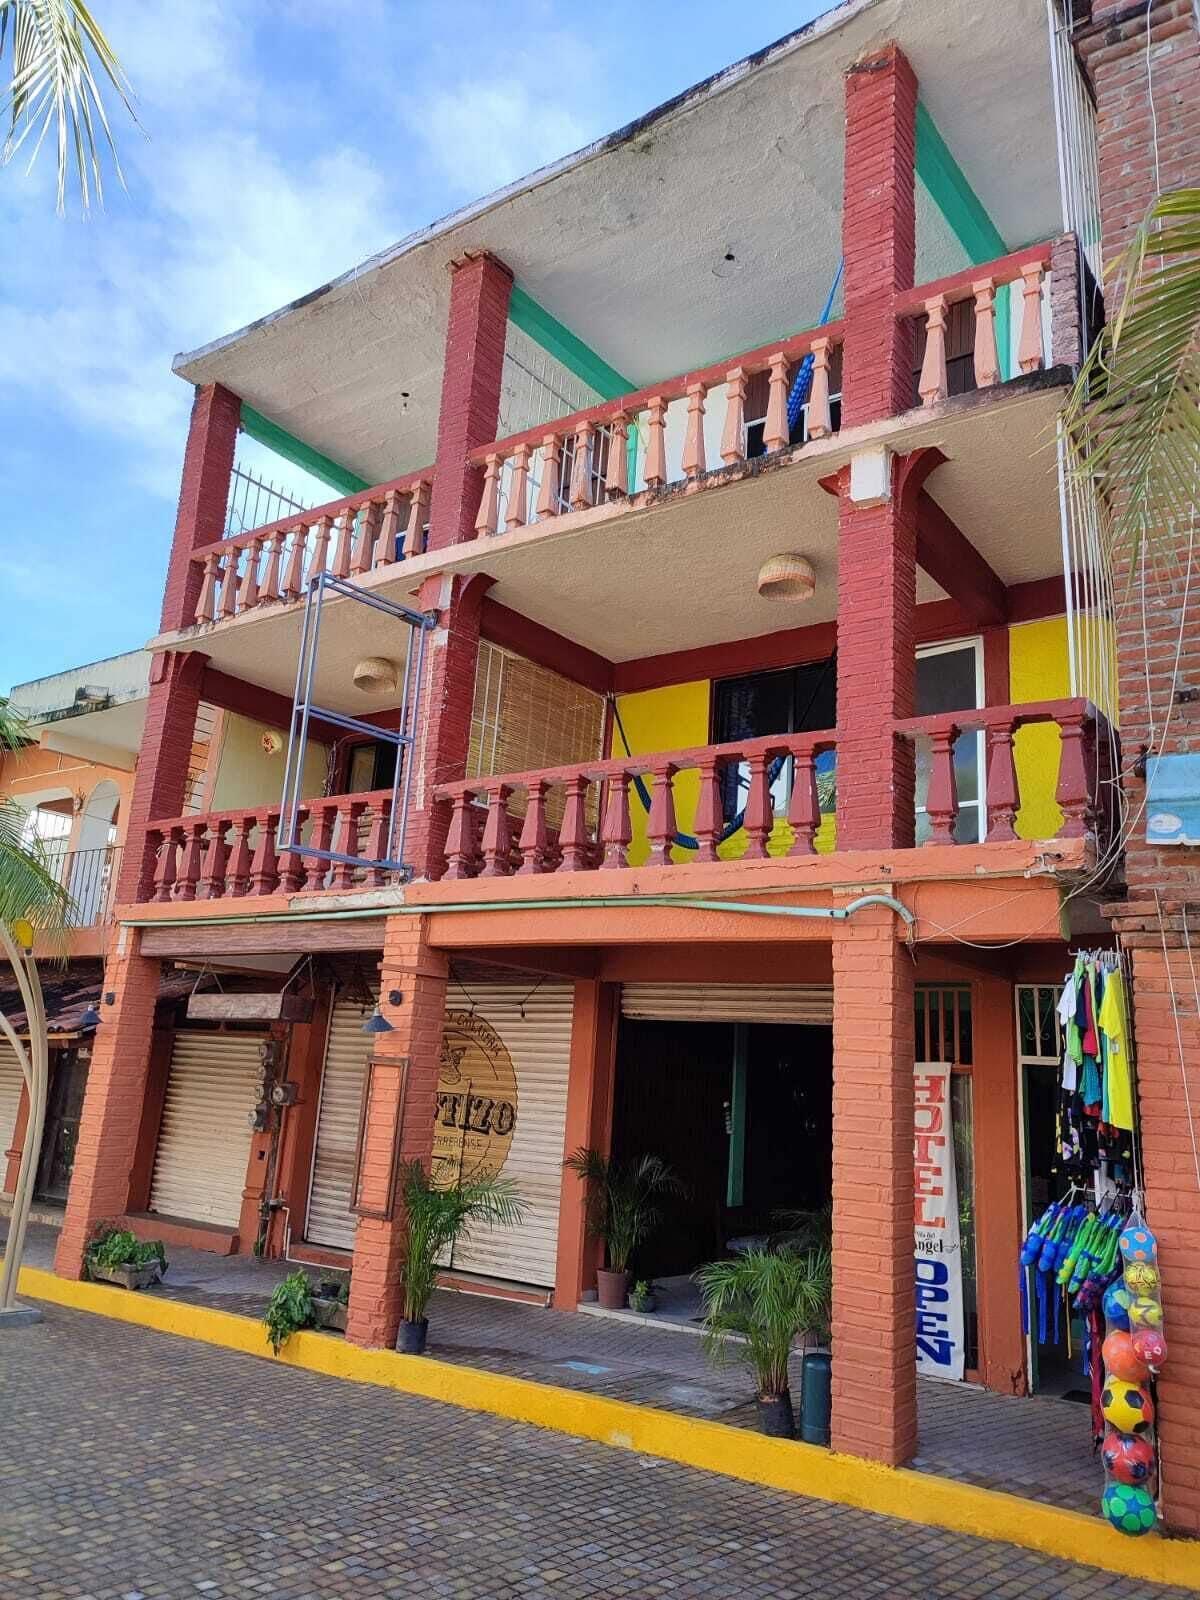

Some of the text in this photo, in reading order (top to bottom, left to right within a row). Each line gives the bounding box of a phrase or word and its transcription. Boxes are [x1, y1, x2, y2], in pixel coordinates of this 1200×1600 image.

[434, 1094, 515, 1136] TIZO
[913, 1075, 946, 1228] HOTEL
[914, 1239, 943, 1255] ngel
[914, 1258, 956, 1366] OPEN
